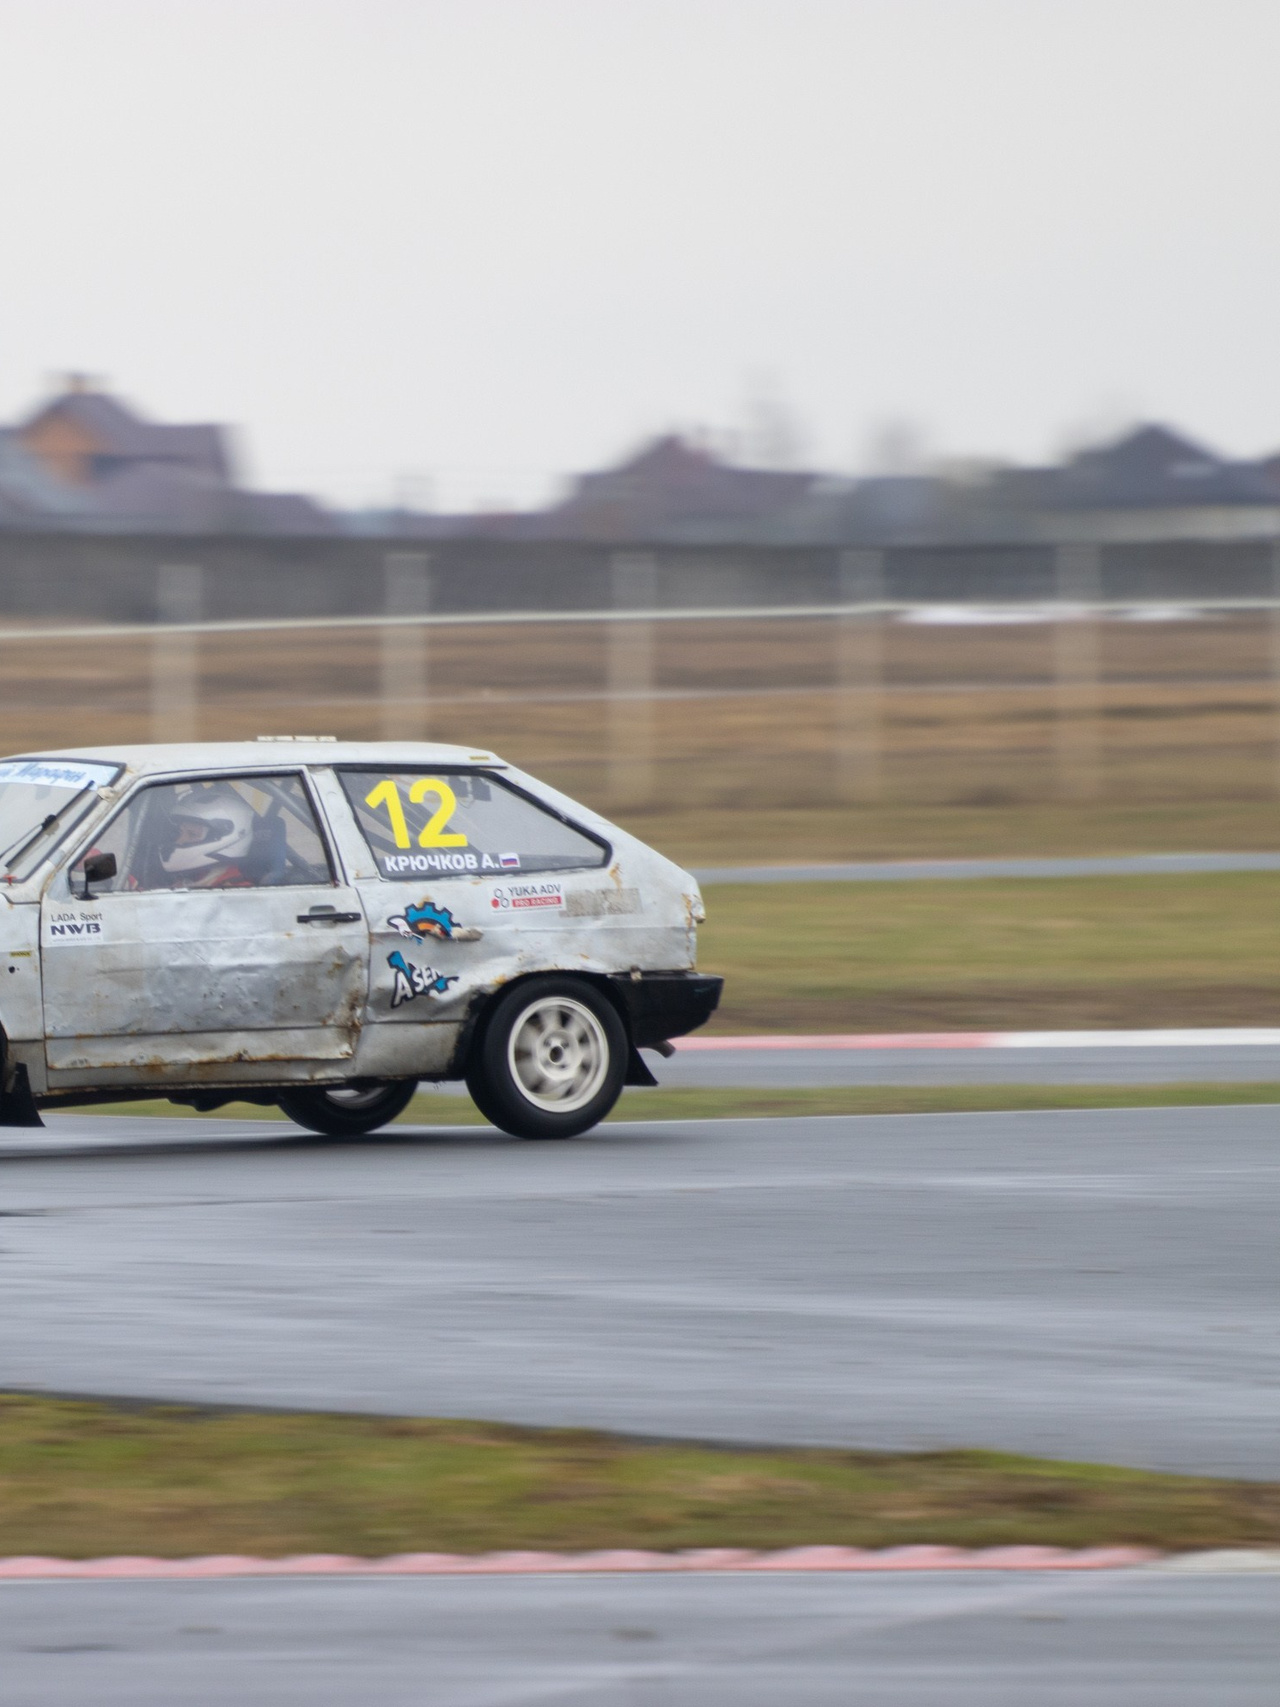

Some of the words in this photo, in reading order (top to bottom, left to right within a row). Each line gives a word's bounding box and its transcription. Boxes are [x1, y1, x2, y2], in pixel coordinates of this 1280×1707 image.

[365, 778, 468, 849] 12
[384, 854, 478, 872] КРЮЧКОВ
[481, 852, 500, 869] А.
[507, 885, 539, 897] YUKA
[540, 884, 562, 895] ADV
[514, 898, 530, 908] PRO
[531, 896, 559, 906] RACING
[51, 913, 76, 922] LADA
[80, 912, 102, 922] Sport
[50, 923, 101, 935] NWB
